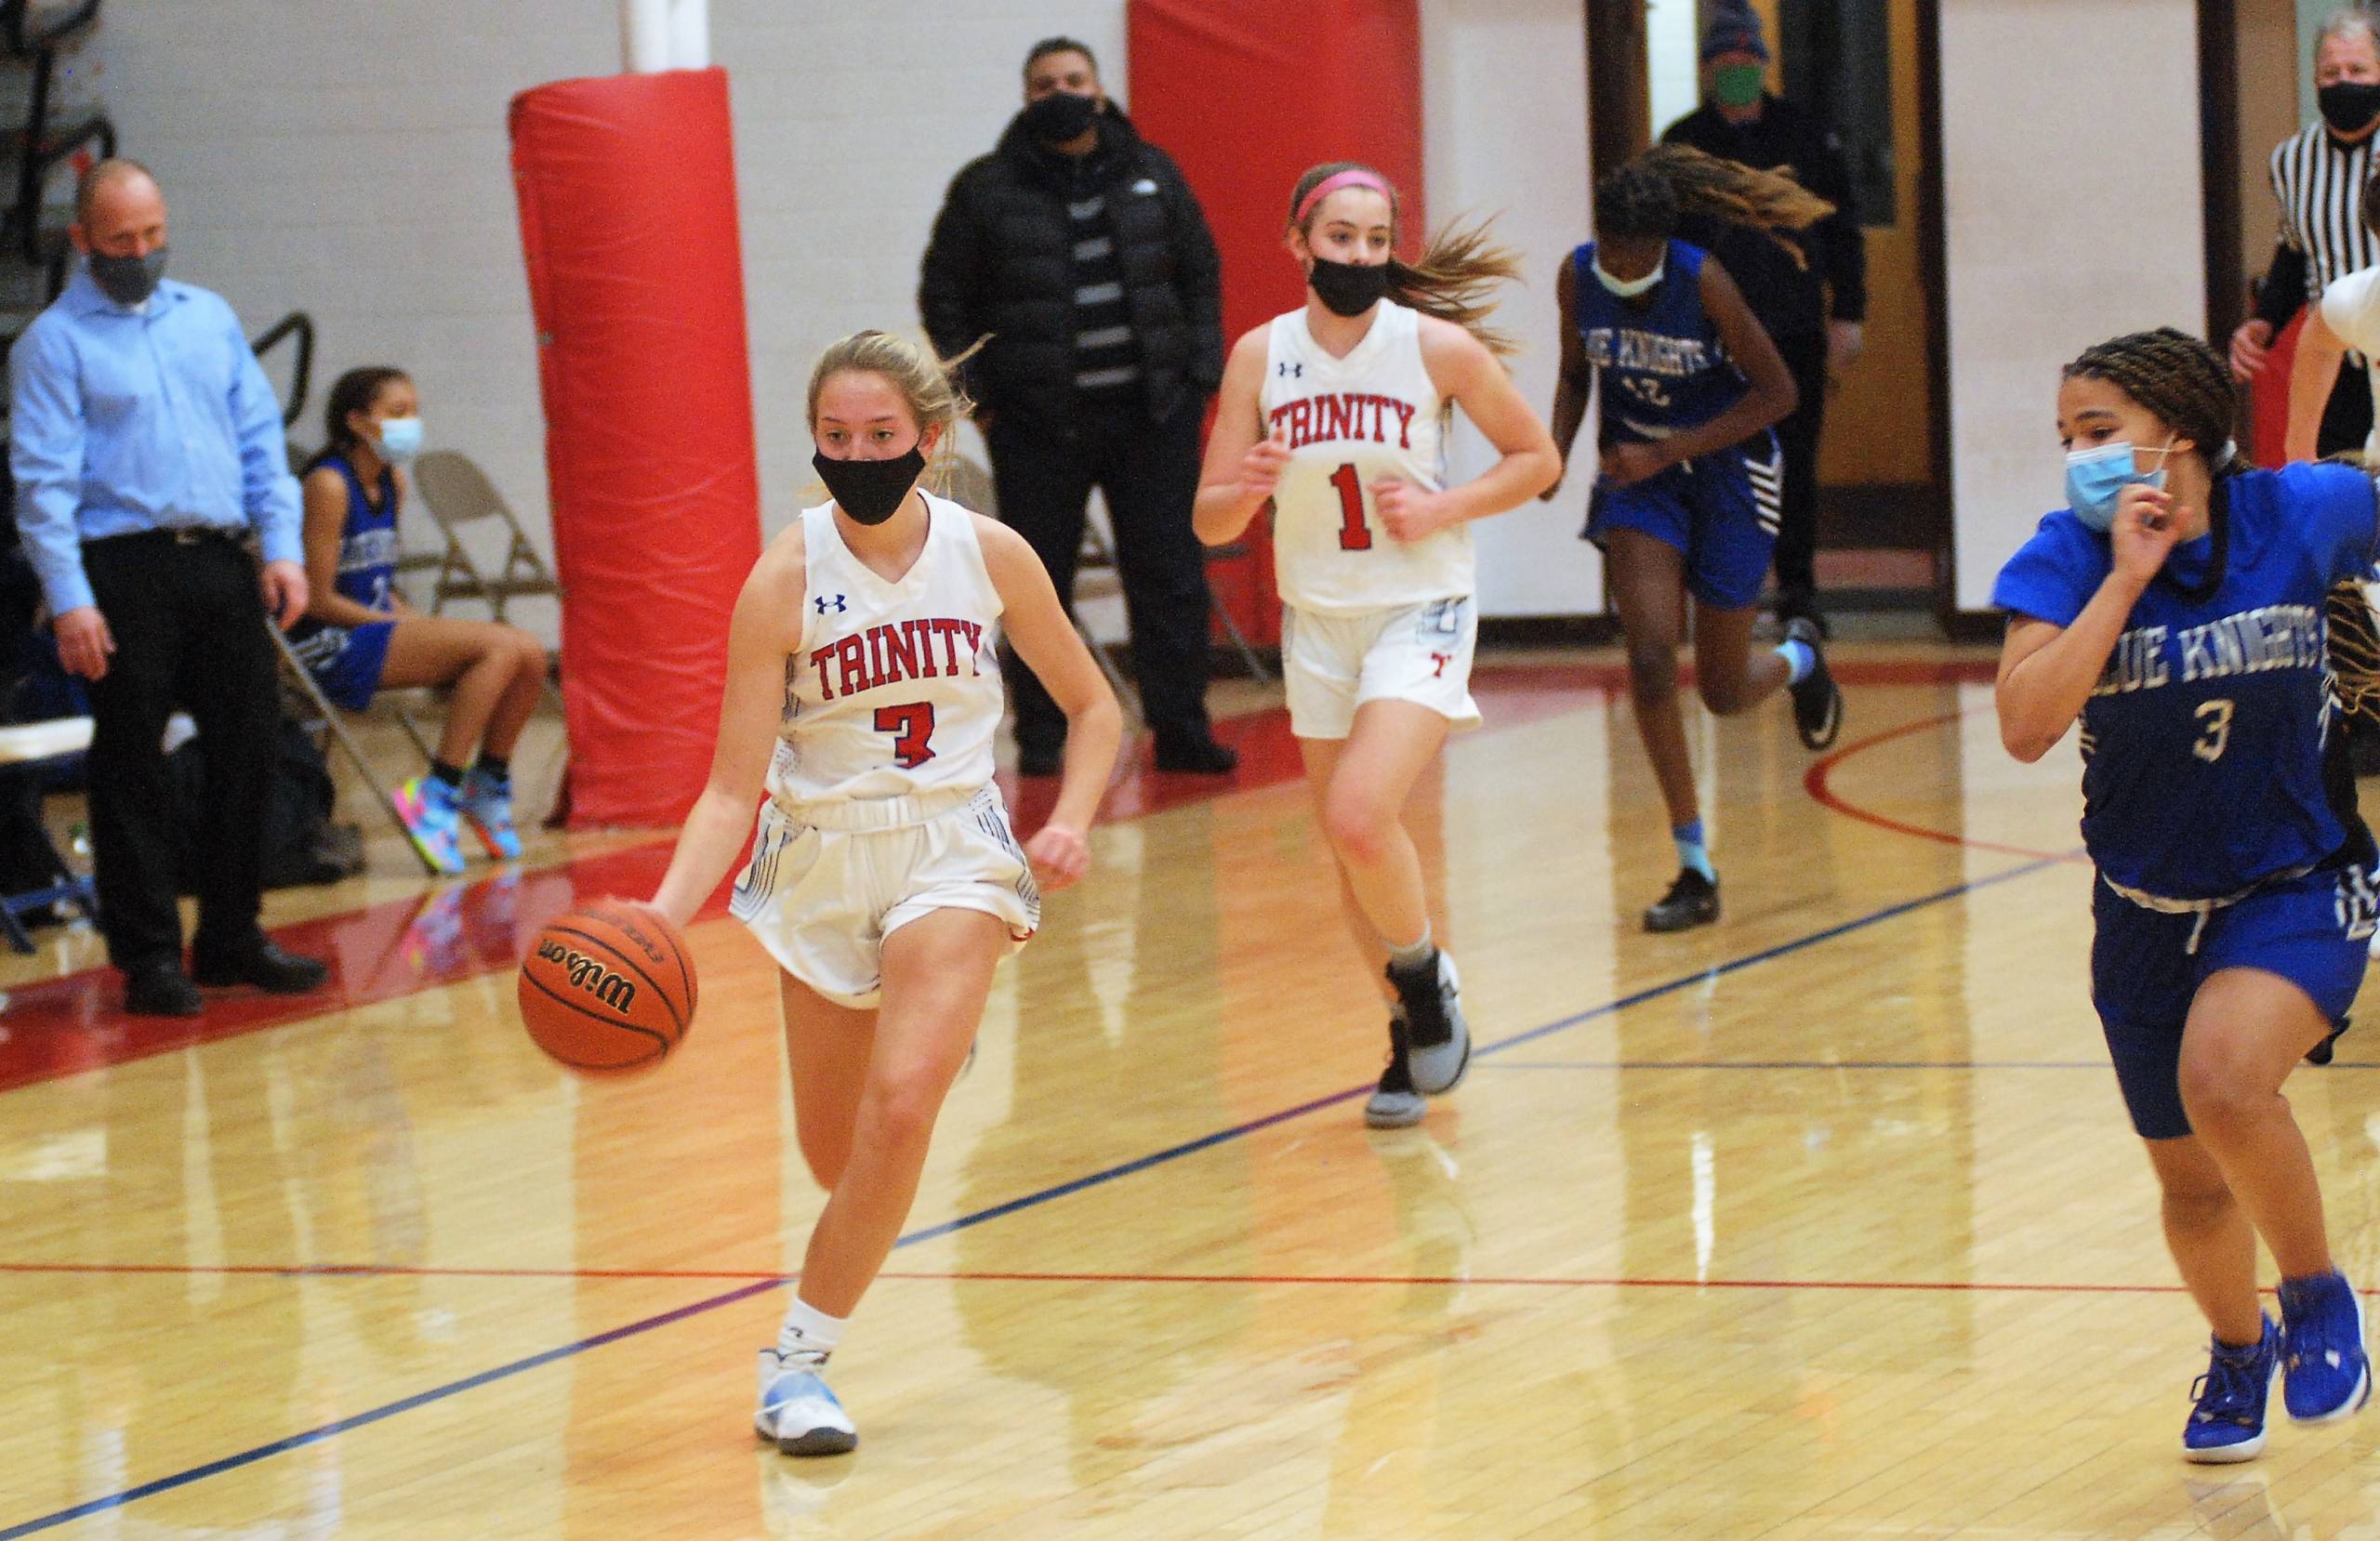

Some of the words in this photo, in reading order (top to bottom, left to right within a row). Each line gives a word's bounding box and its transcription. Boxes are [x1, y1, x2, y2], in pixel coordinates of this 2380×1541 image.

[1269, 393, 1415, 450] TRINITY
[1329, 463, 1372, 550] 1
[810, 618, 983, 700] TRINITY
[874, 701, 936, 770] 3
[2193, 699, 2235, 762] 3
[537, 938, 637, 1016] Wilson
